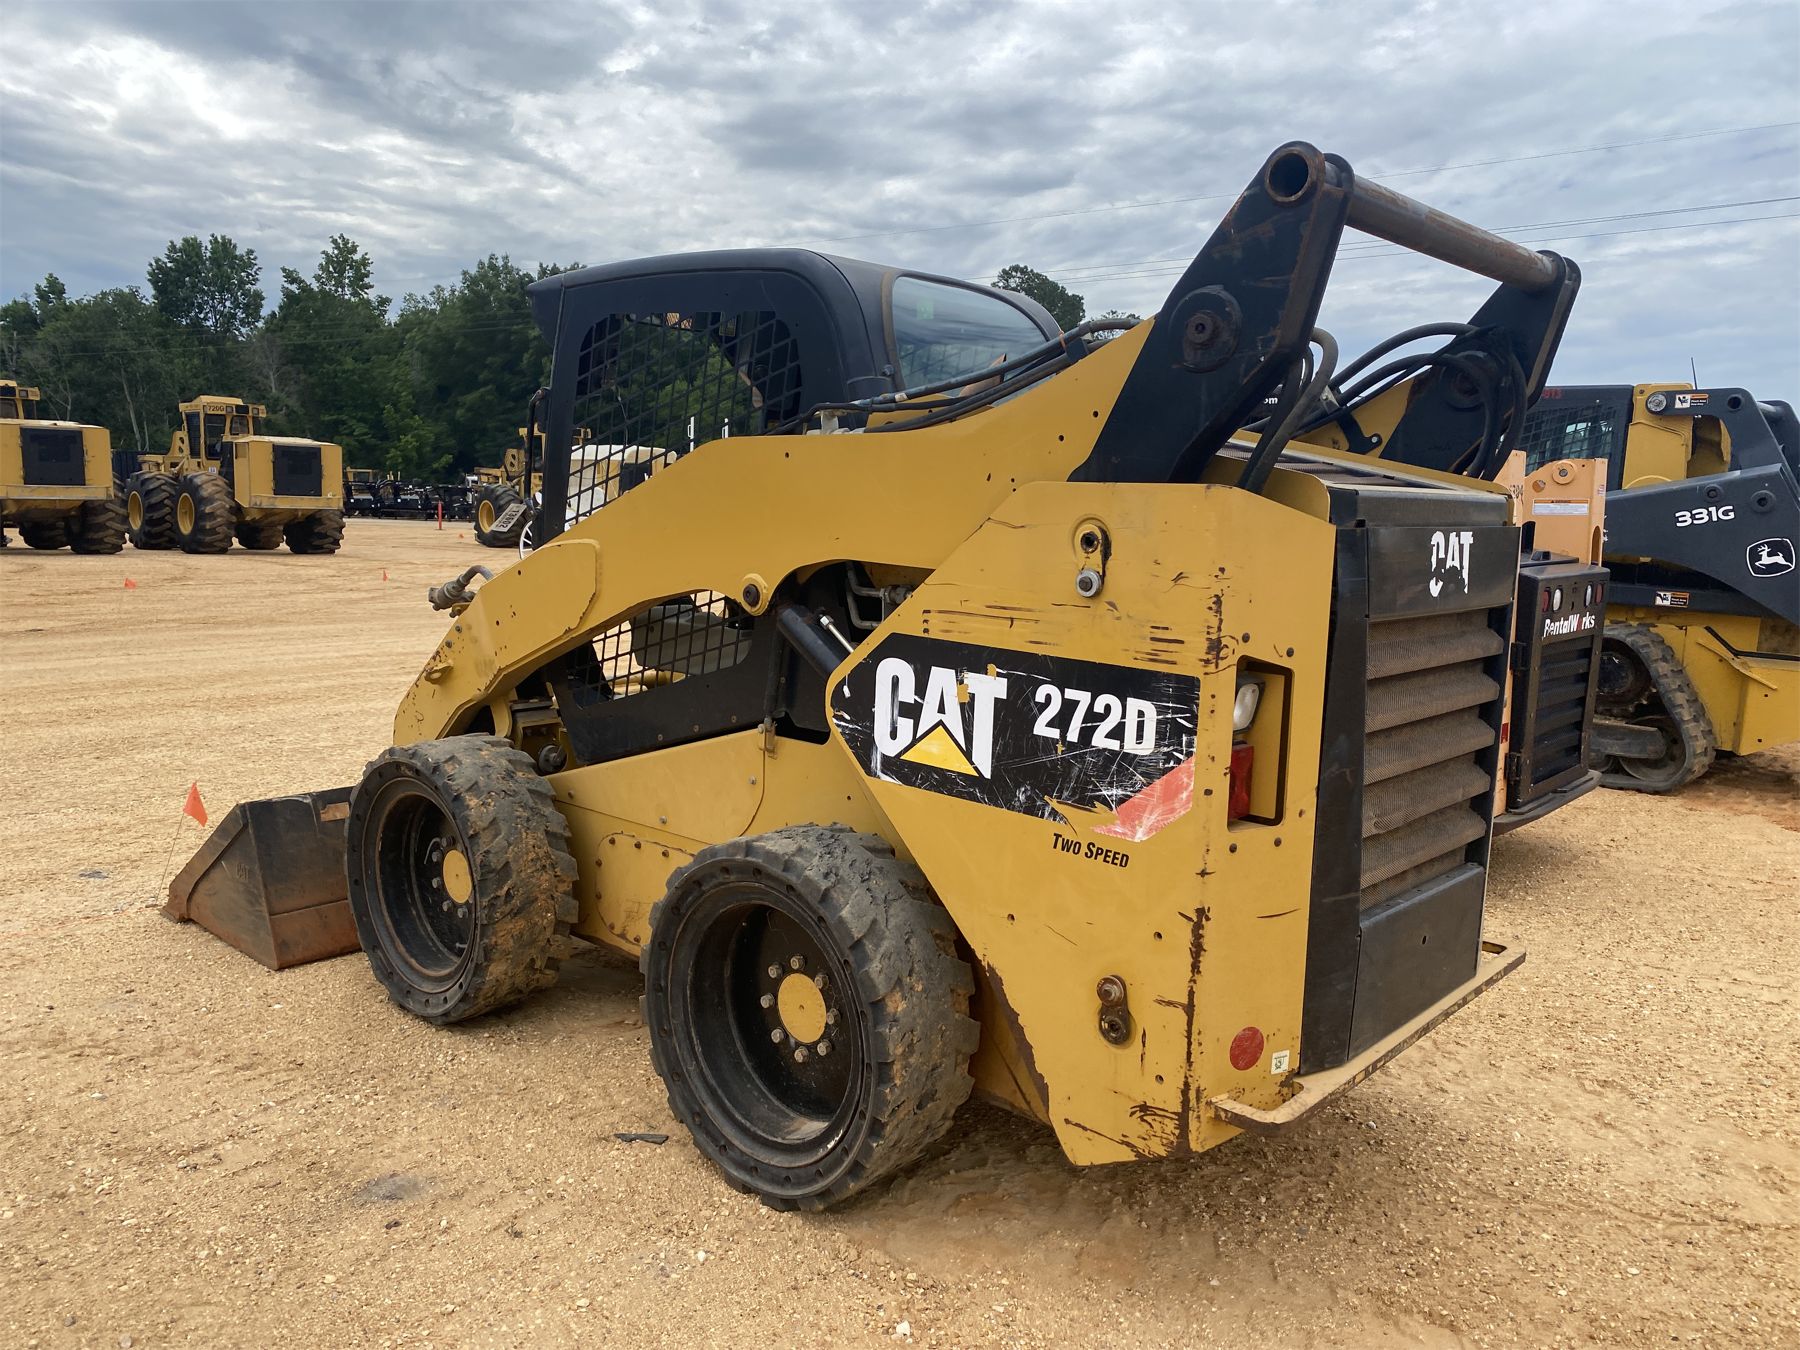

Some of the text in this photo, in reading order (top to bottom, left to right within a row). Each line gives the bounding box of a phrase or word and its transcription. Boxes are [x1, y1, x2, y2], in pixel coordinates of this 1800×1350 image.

[1675, 505, 1735, 527] 331G
[1429, 530, 1474, 597] CAT
[873, 657, 1158, 779] CAT 272D
